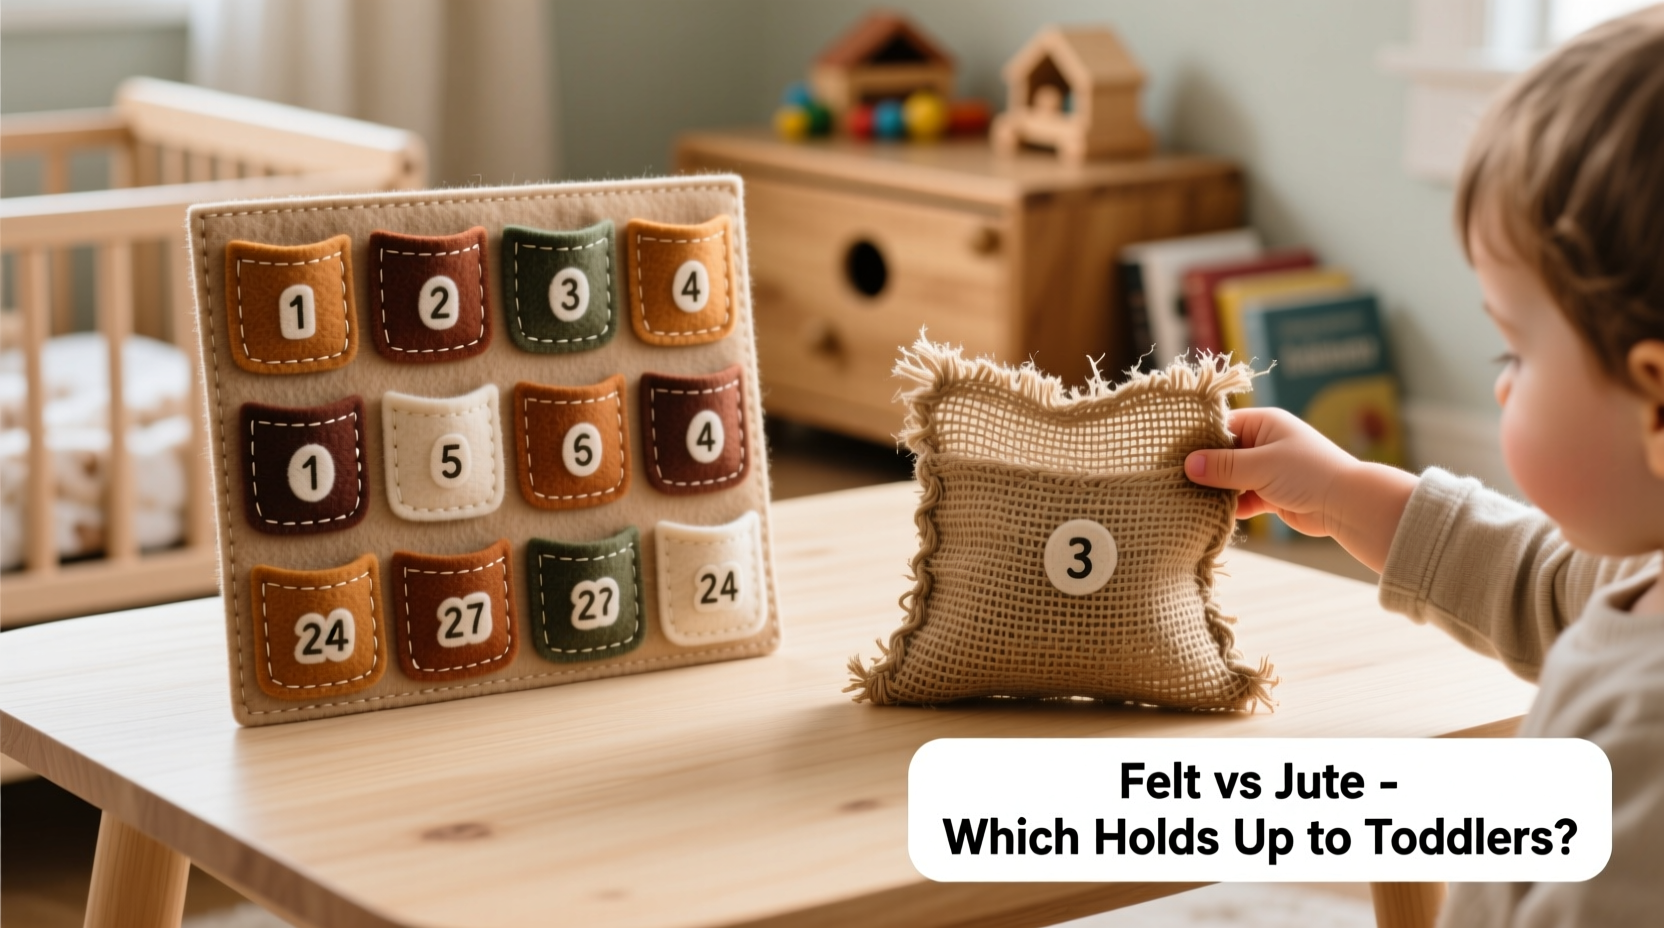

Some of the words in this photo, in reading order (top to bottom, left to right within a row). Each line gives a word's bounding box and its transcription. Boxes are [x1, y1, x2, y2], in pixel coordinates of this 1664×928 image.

[431, 286, 449, 319] 2
[562, 278, 579, 311] 3
[681, 271, 700, 302] 4
[290, 295, 304, 329] 1
[696, 422, 715, 451] 4
[302, 455, 317, 490] 1
[442, 444, 461, 478] 5
[1067, 537, 1092, 579] 3
[701, 571, 737, 604] 24
[303, 620, 348, 655] 24
[445, 602, 483, 639] 27
